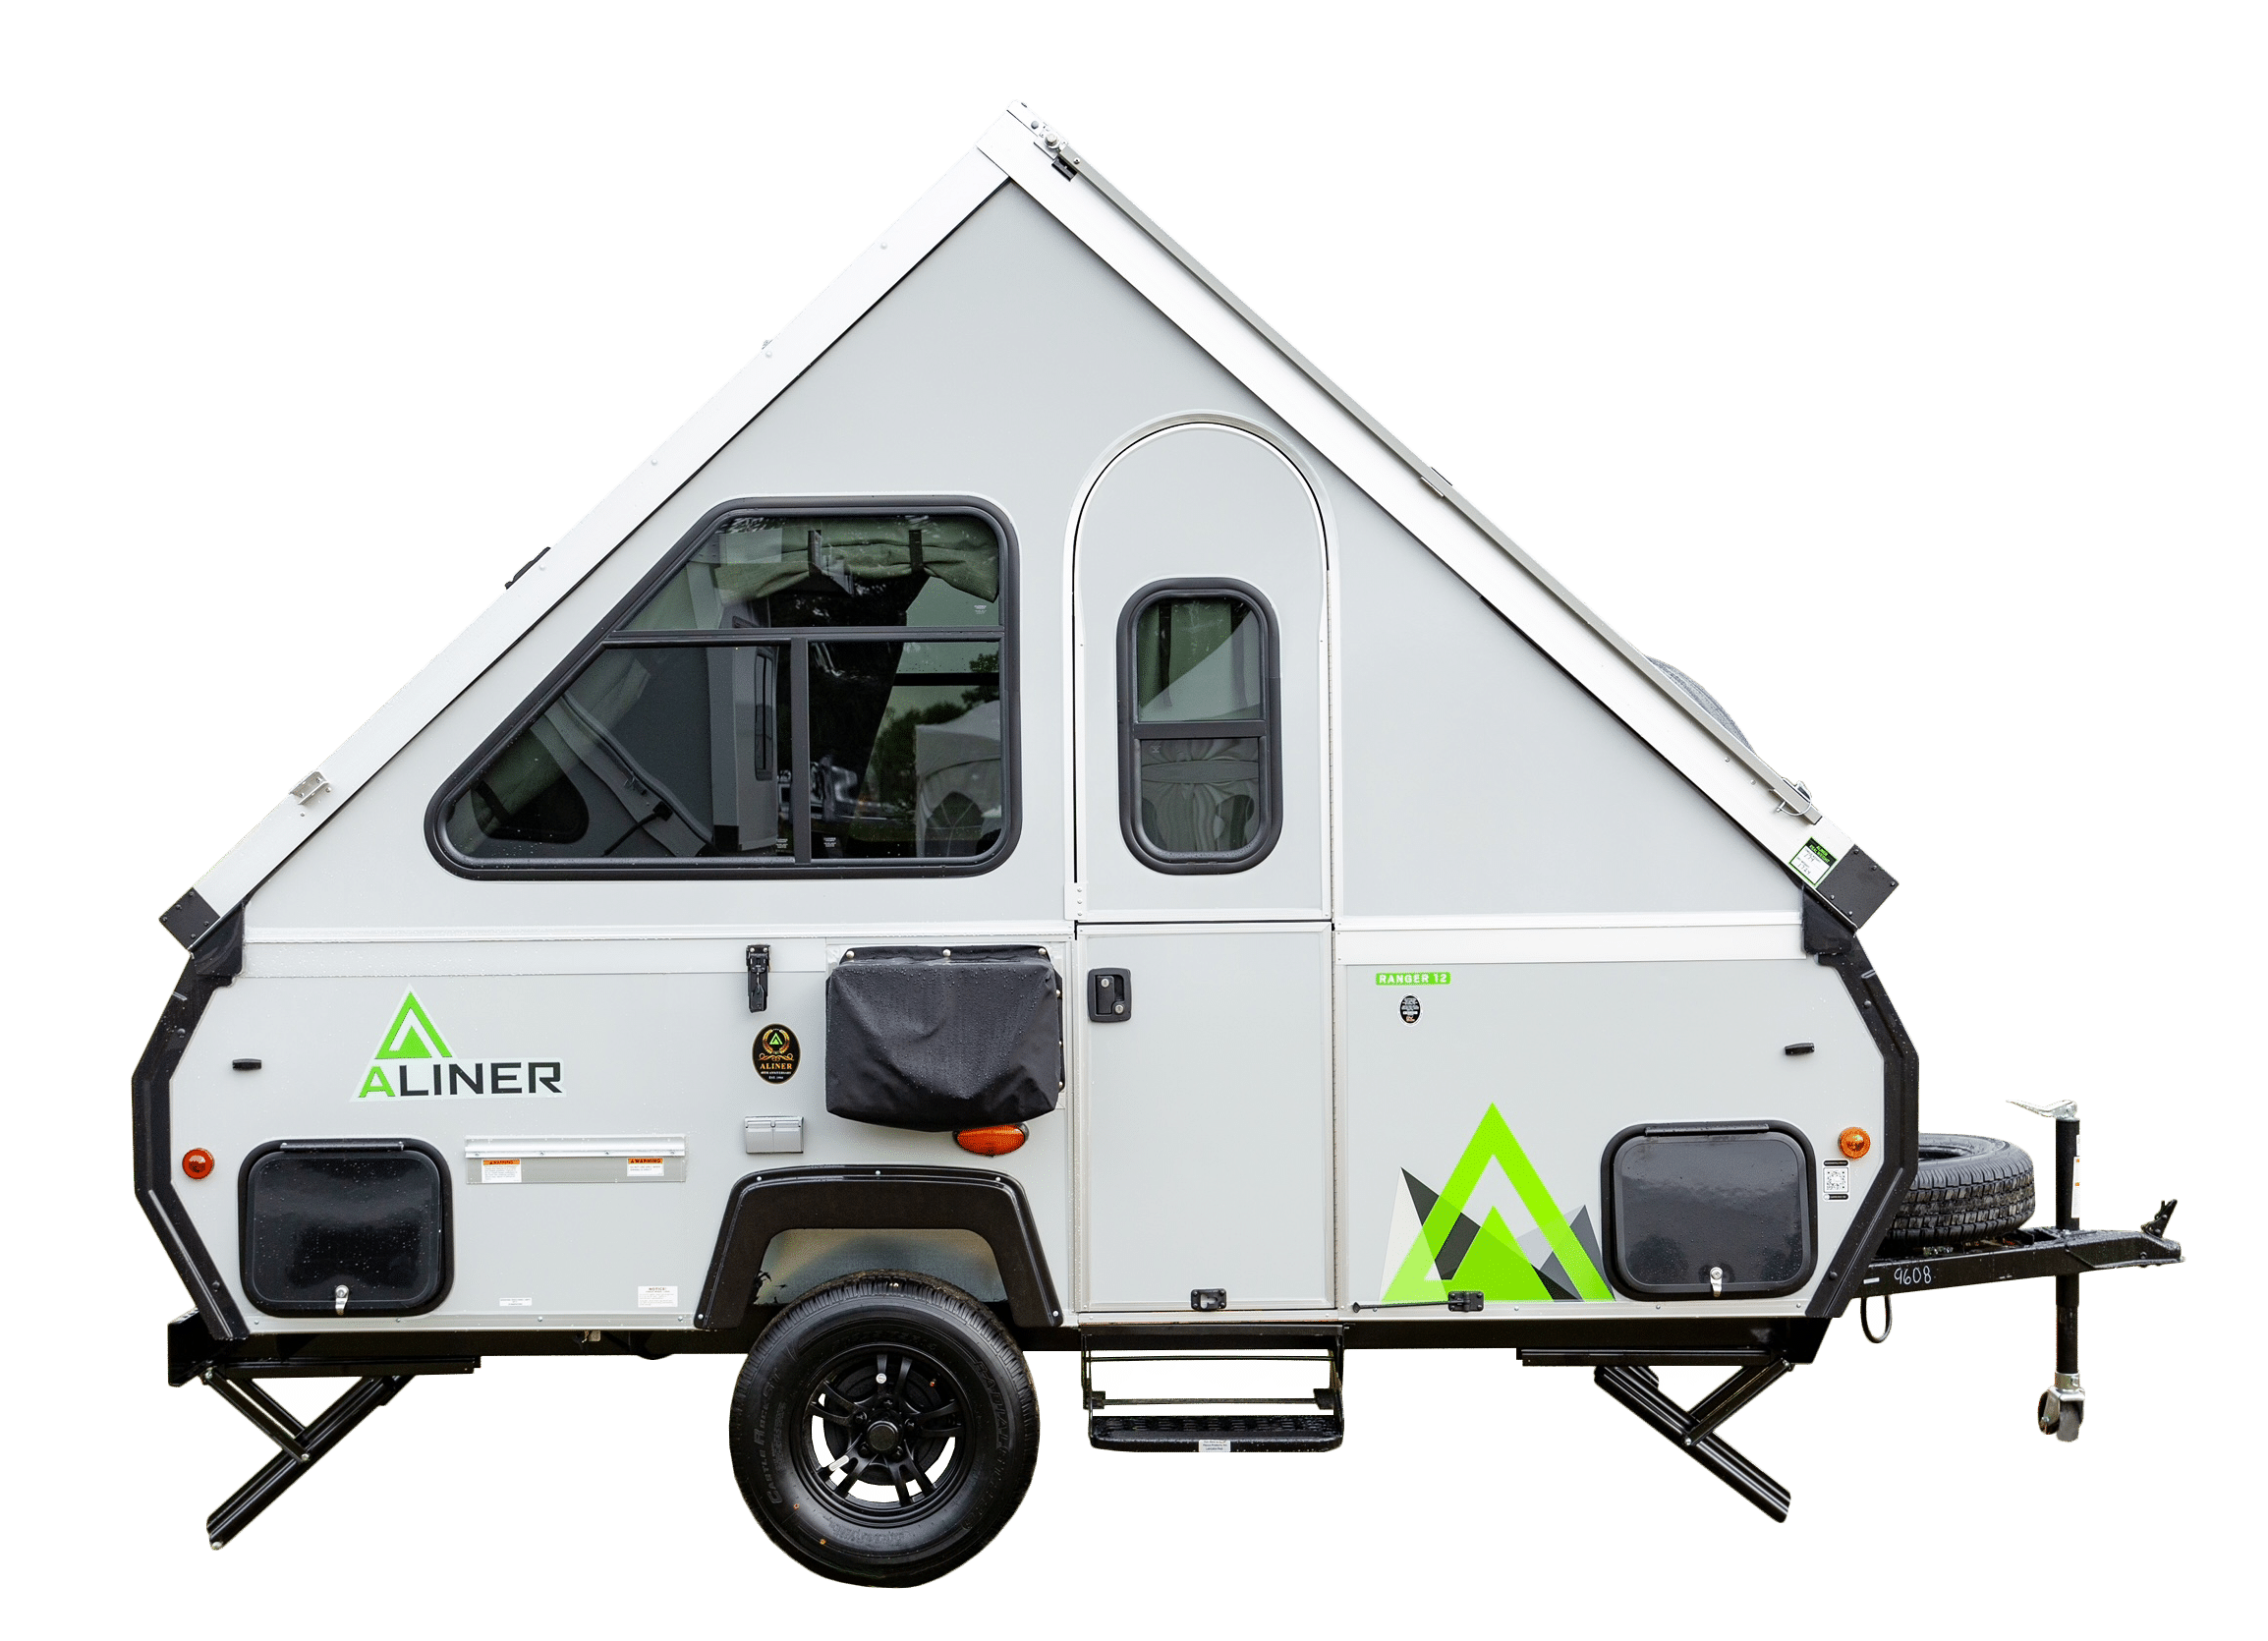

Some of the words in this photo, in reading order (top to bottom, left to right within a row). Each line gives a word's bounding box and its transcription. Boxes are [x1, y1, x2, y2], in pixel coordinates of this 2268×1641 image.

[1379, 974, 1429, 984] RANGER
[1434, 973, 1446, 983] 12
[359, 1061, 563, 1098] ALINER
[1894, 1265, 1932, 1285] 9608
